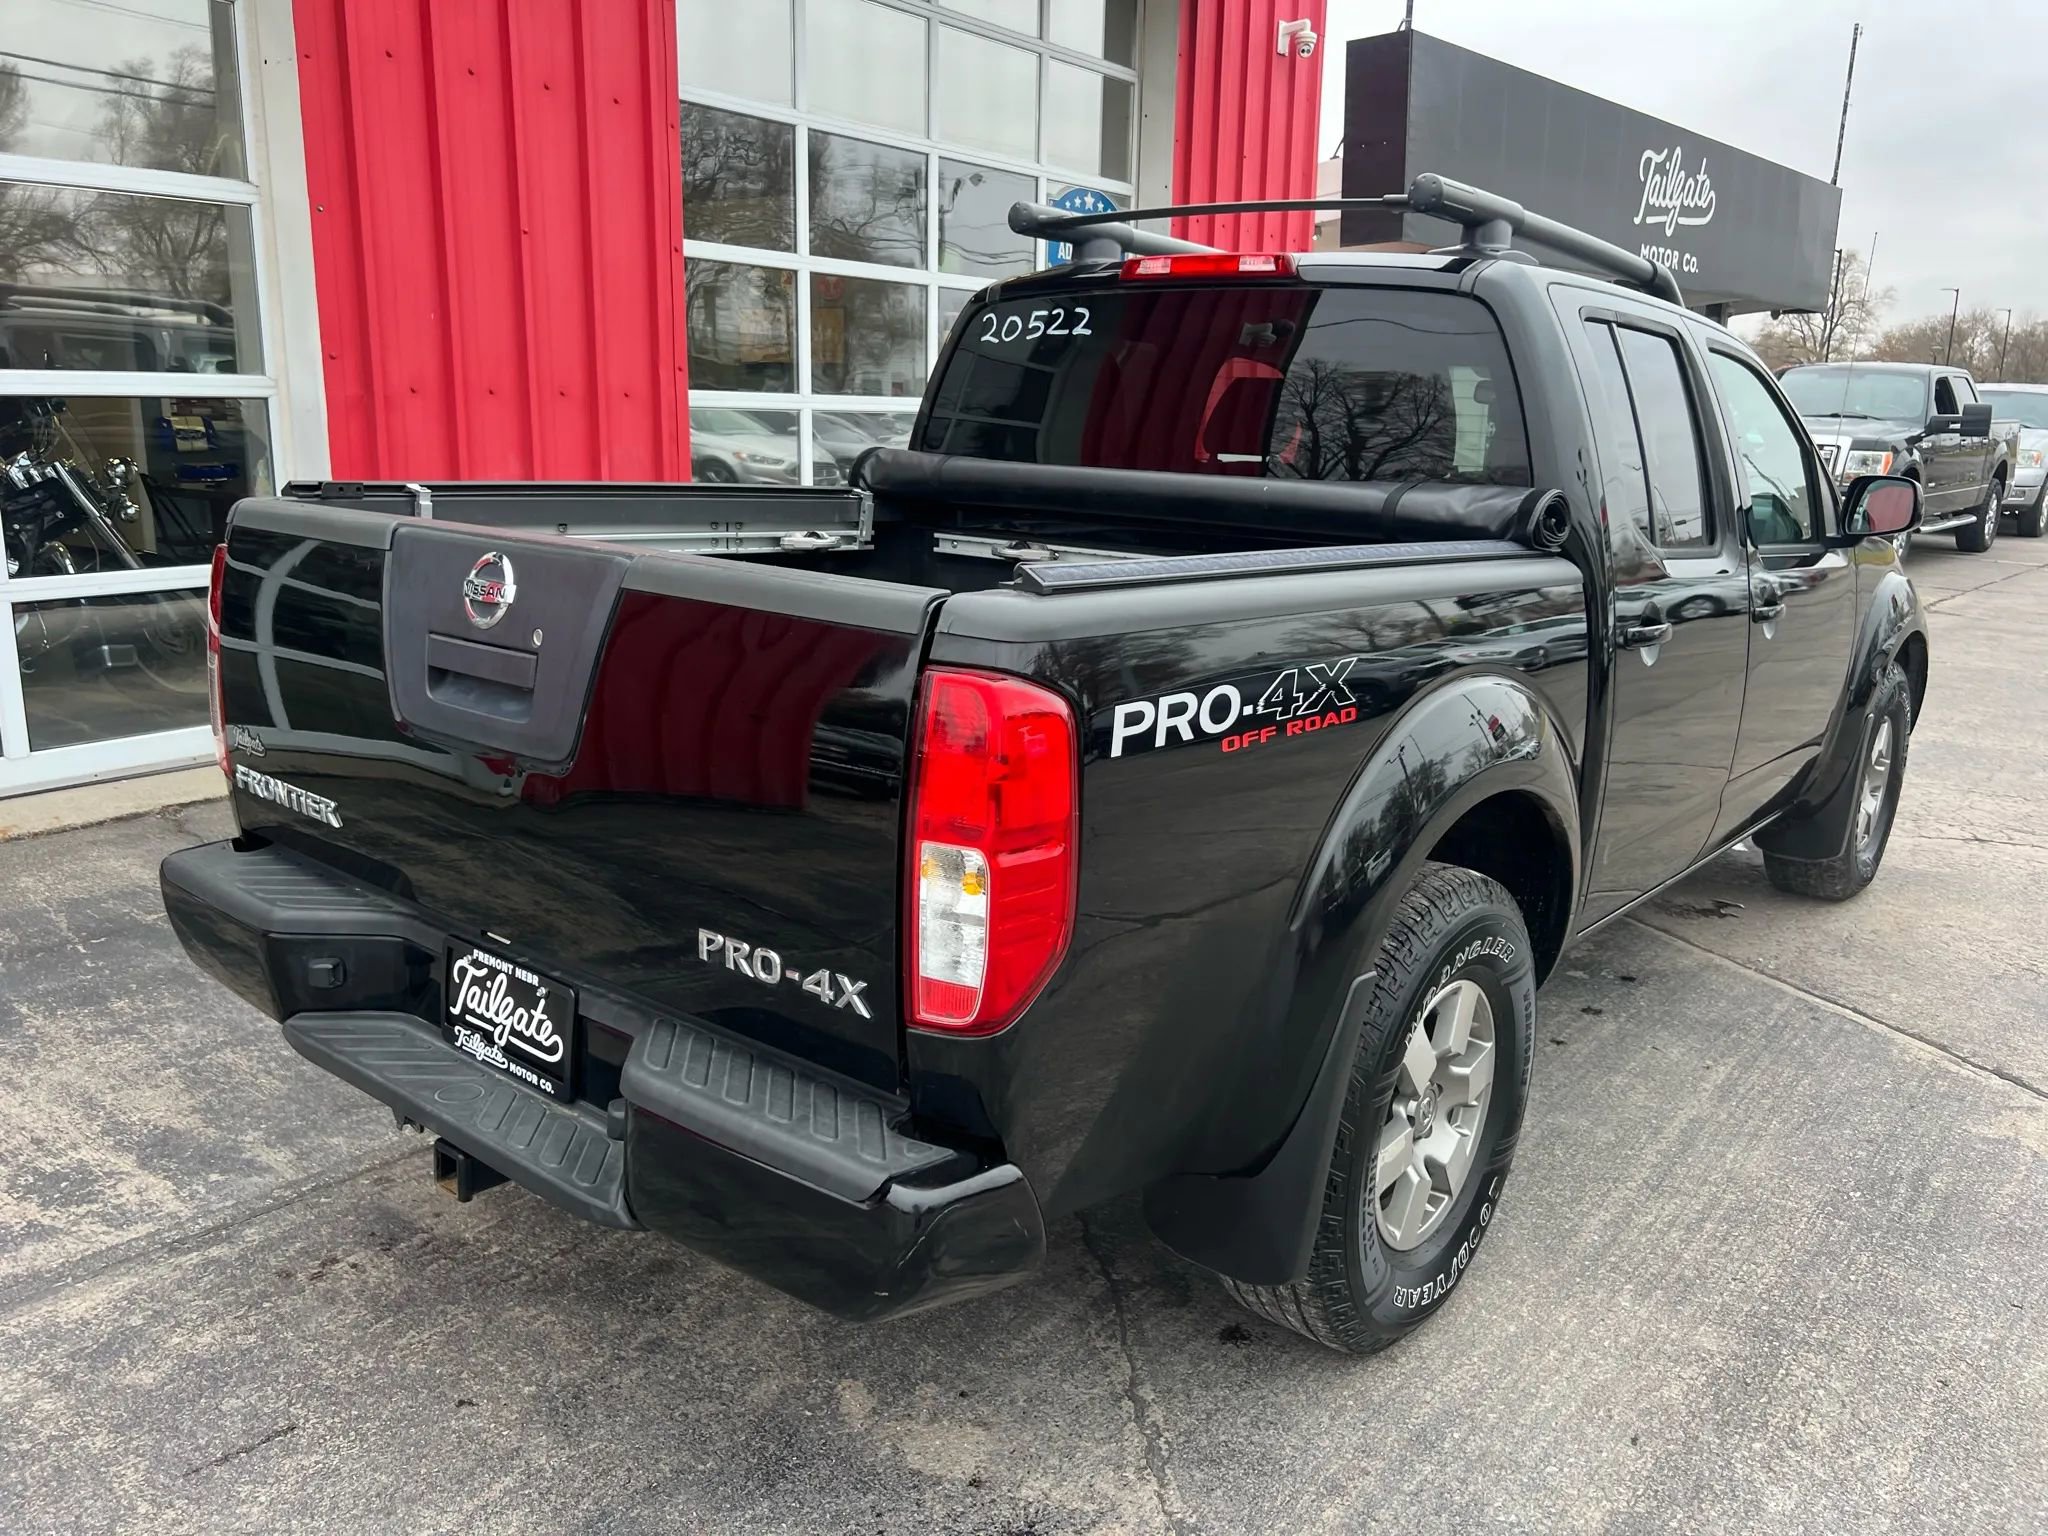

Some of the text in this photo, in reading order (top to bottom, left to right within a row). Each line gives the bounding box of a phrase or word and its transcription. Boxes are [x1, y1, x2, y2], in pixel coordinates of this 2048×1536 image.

[1633, 146, 1716, 237] Tailgate
[1640, 243, 1679, 271] MOTOR
[980, 307, 1092, 343] 20522
[464, 580, 506, 599] NISSAN
[1221, 707, 1359, 753] OFF ROAD
[235, 763, 344, 829] FRONTIER
[473, 948, 539, 987] FREMONT NEBR
[698, 927, 872, 1020] PRO-4X
[449, 958, 564, 1063] Tailgate
[454, 1025, 509, 1069] Tailgate
[509, 1061, 538, 1086] MOTOR
